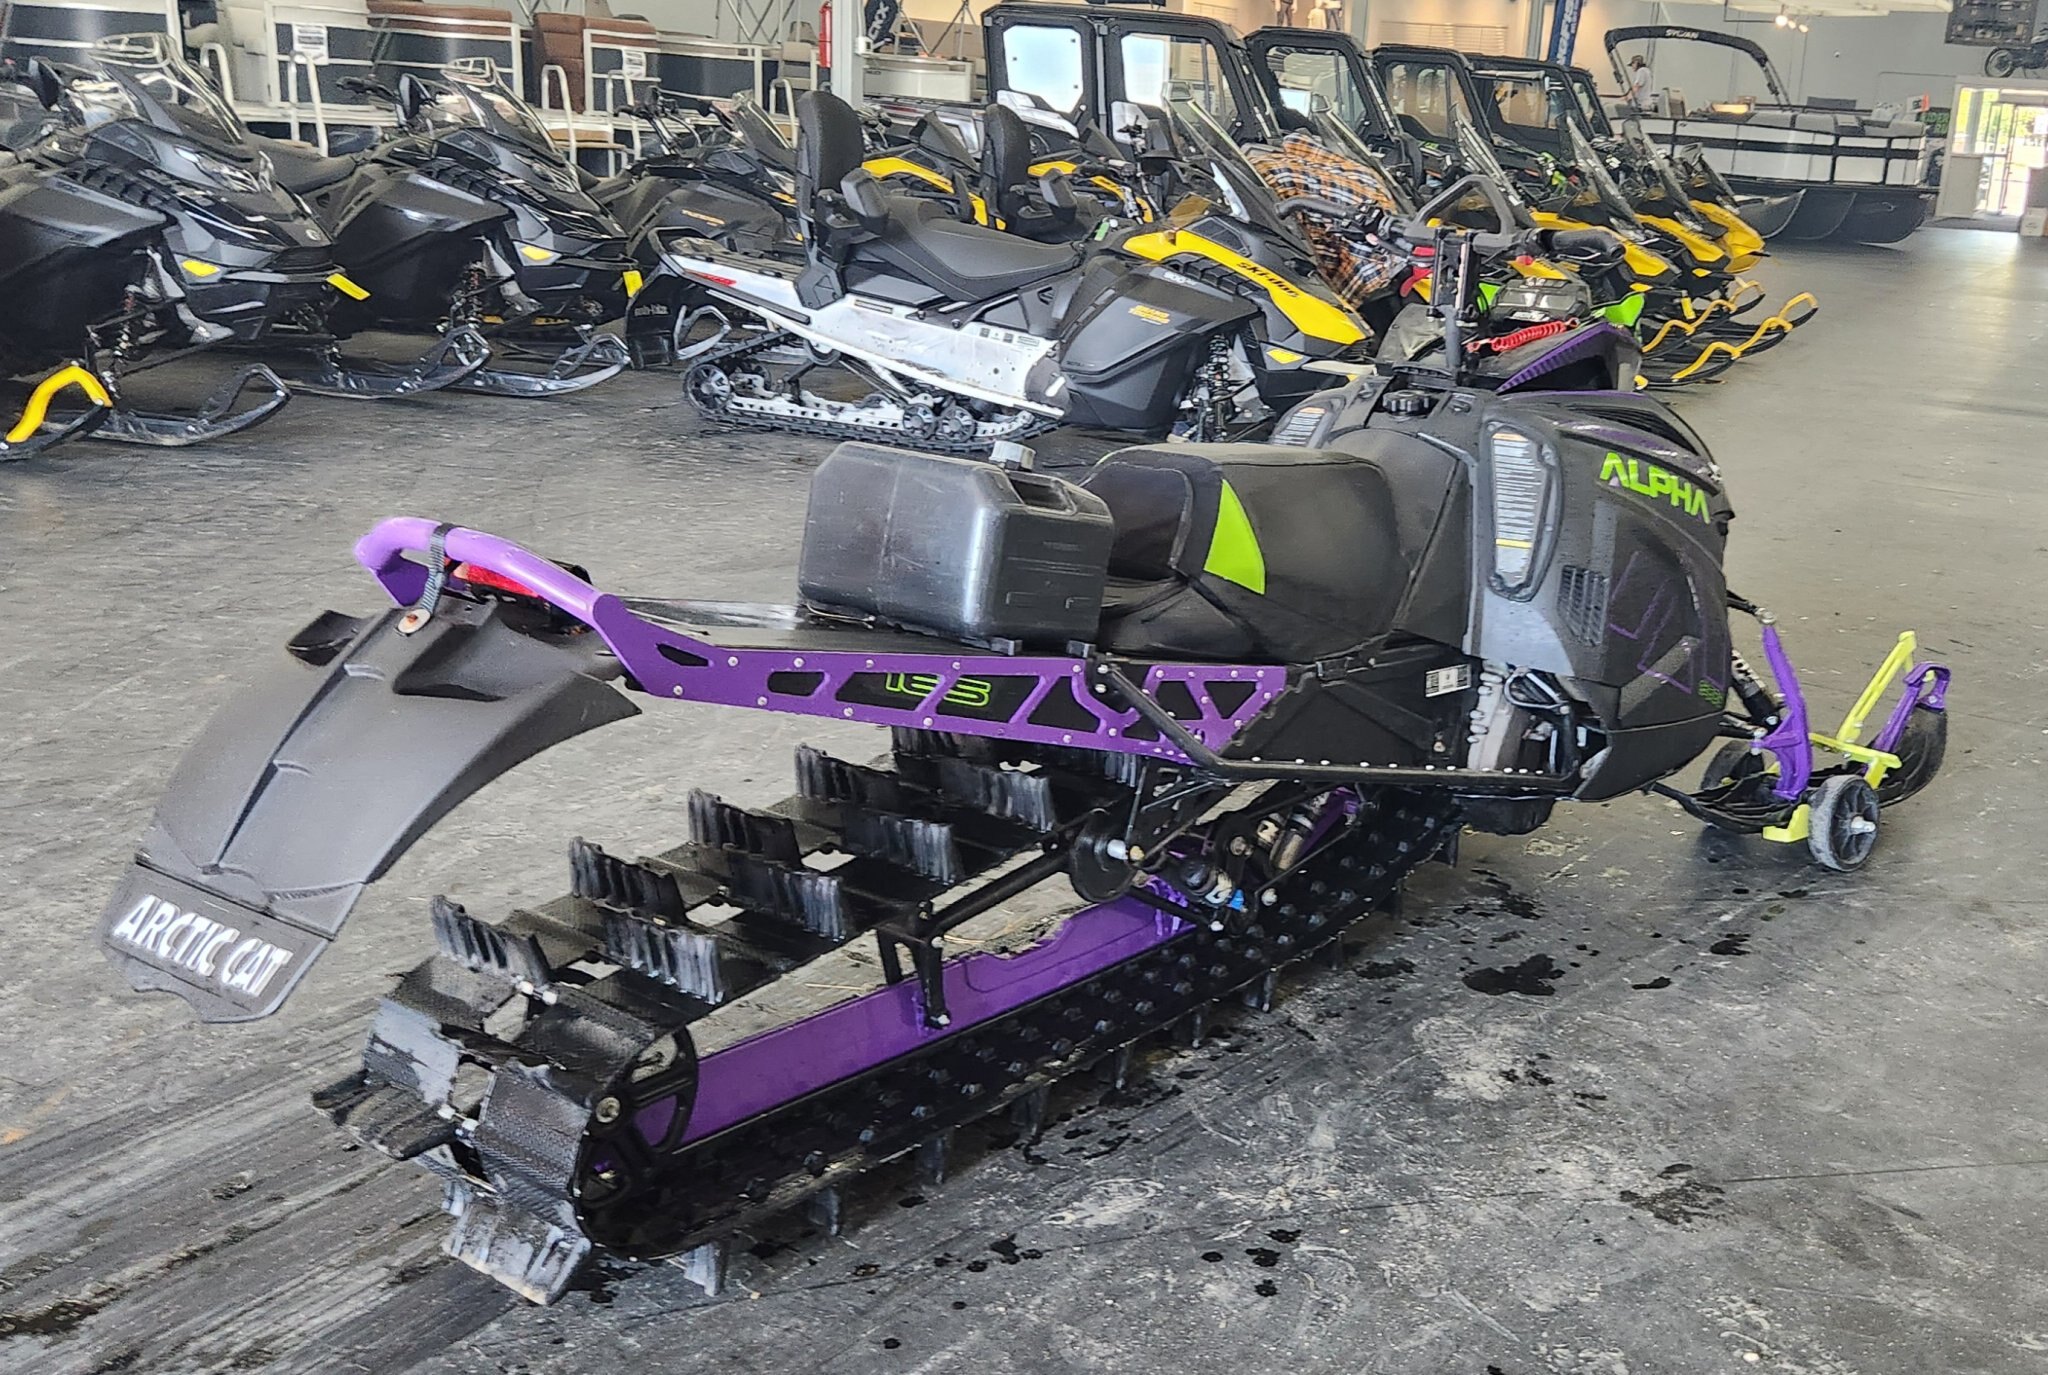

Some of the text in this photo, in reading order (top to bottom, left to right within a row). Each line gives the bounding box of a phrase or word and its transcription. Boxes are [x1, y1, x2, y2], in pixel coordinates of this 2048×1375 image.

[1600, 452, 1711, 525] ALPHA
[113, 894, 293, 997] ARCTIC CAT
